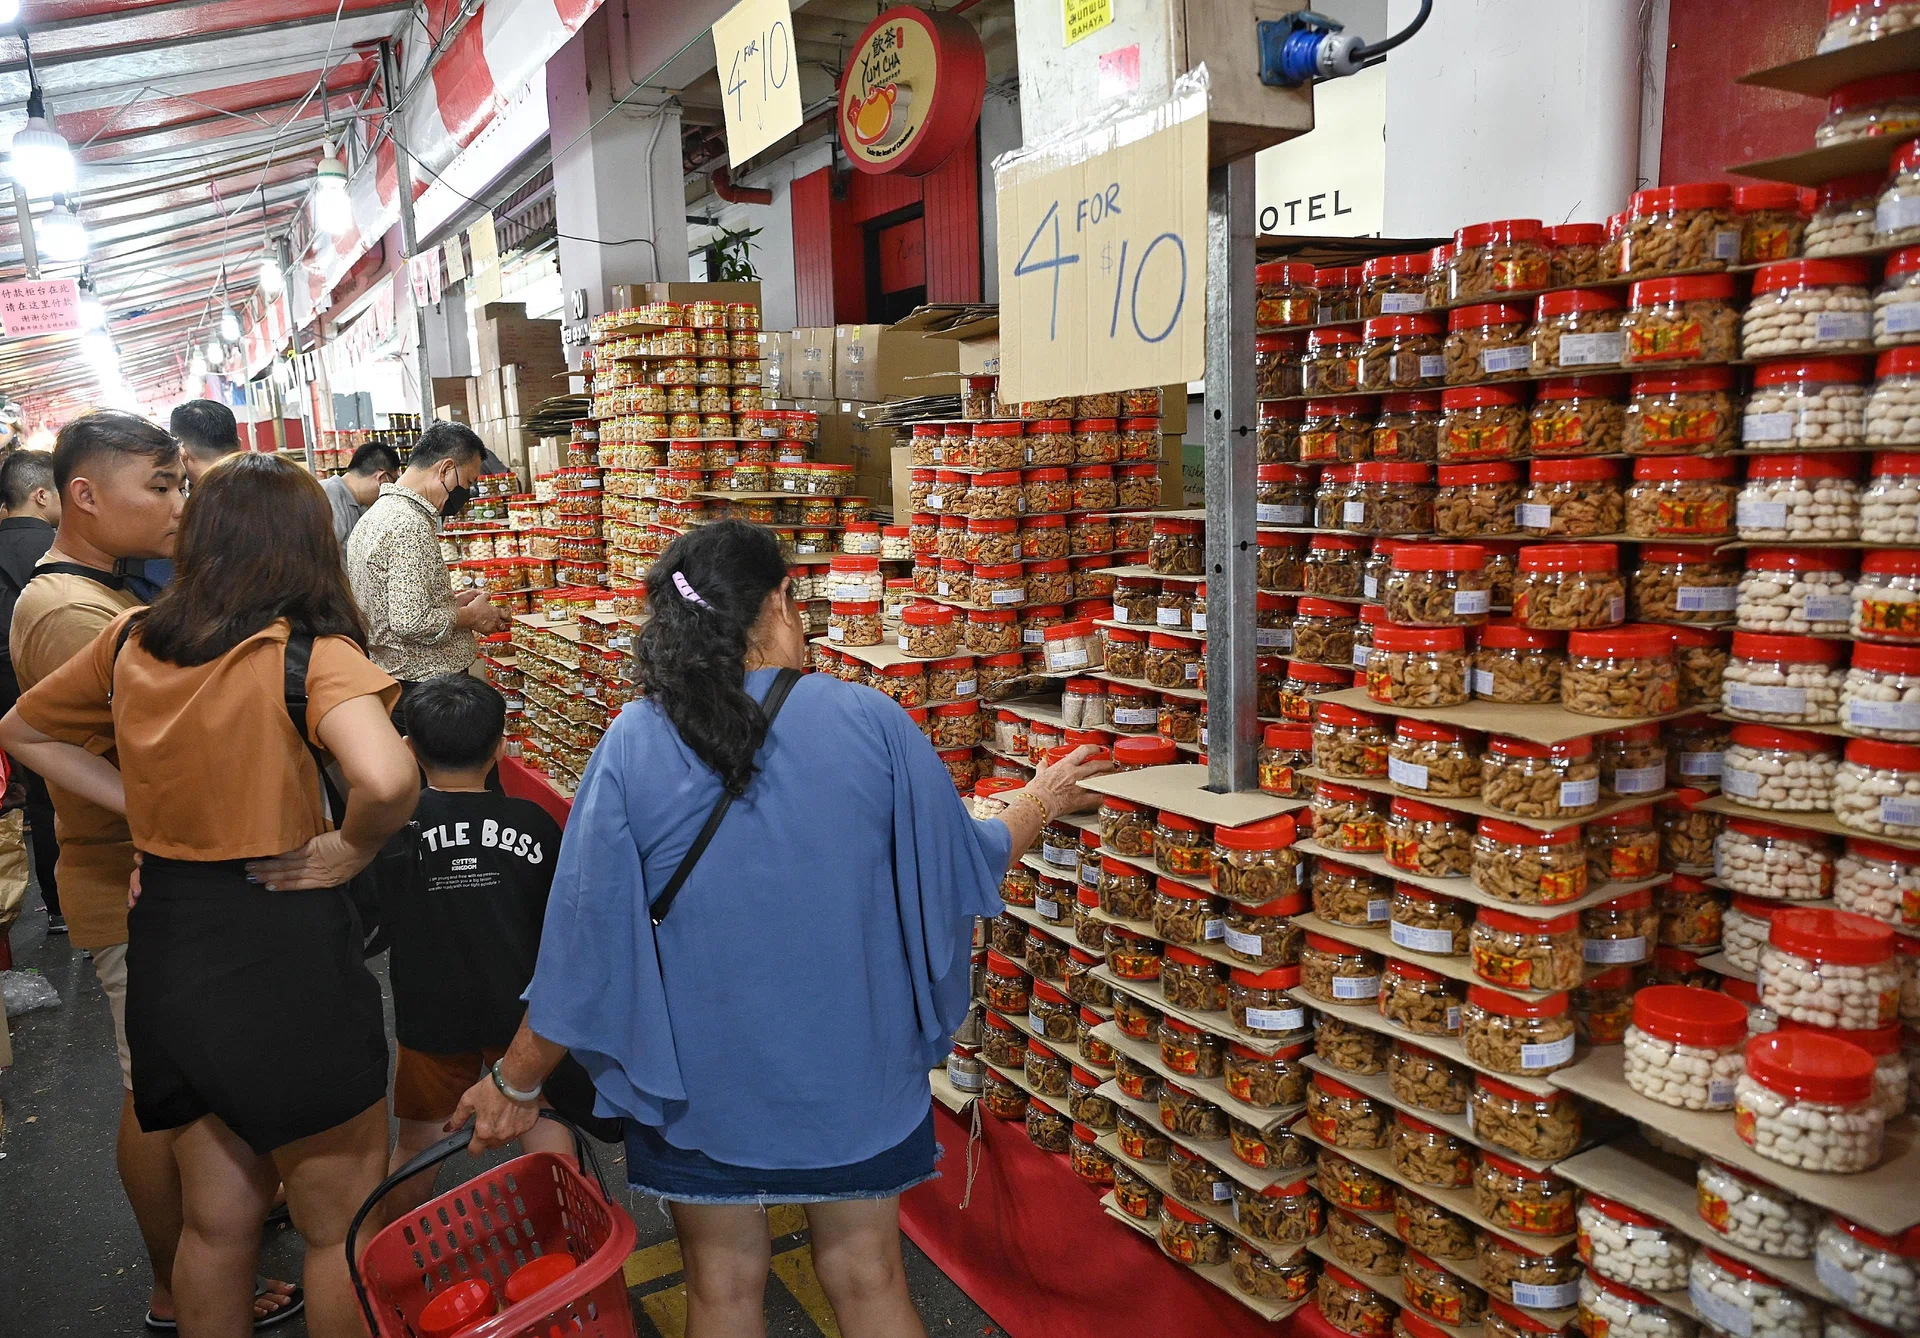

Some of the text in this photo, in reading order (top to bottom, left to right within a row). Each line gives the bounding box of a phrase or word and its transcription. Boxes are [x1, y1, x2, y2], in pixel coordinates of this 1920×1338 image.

[1071, 14, 1104, 38] BAHAYA
[728, 21, 789, 121] 4 FOR 10
[861, 52, 900, 97] YUM CHA
[1260, 189, 1352, 231] OTEL
[1014, 200, 1080, 341] 4
[1077, 182, 1121, 232] FOR
[1, 284, 70, 299] 付款柜台在此
[5, 297, 73, 312] 请在这里付款
[419, 822, 470, 860] TLE
[451, 857, 477, 865] COTTON
[451, 864, 477, 872] KINGDOM
